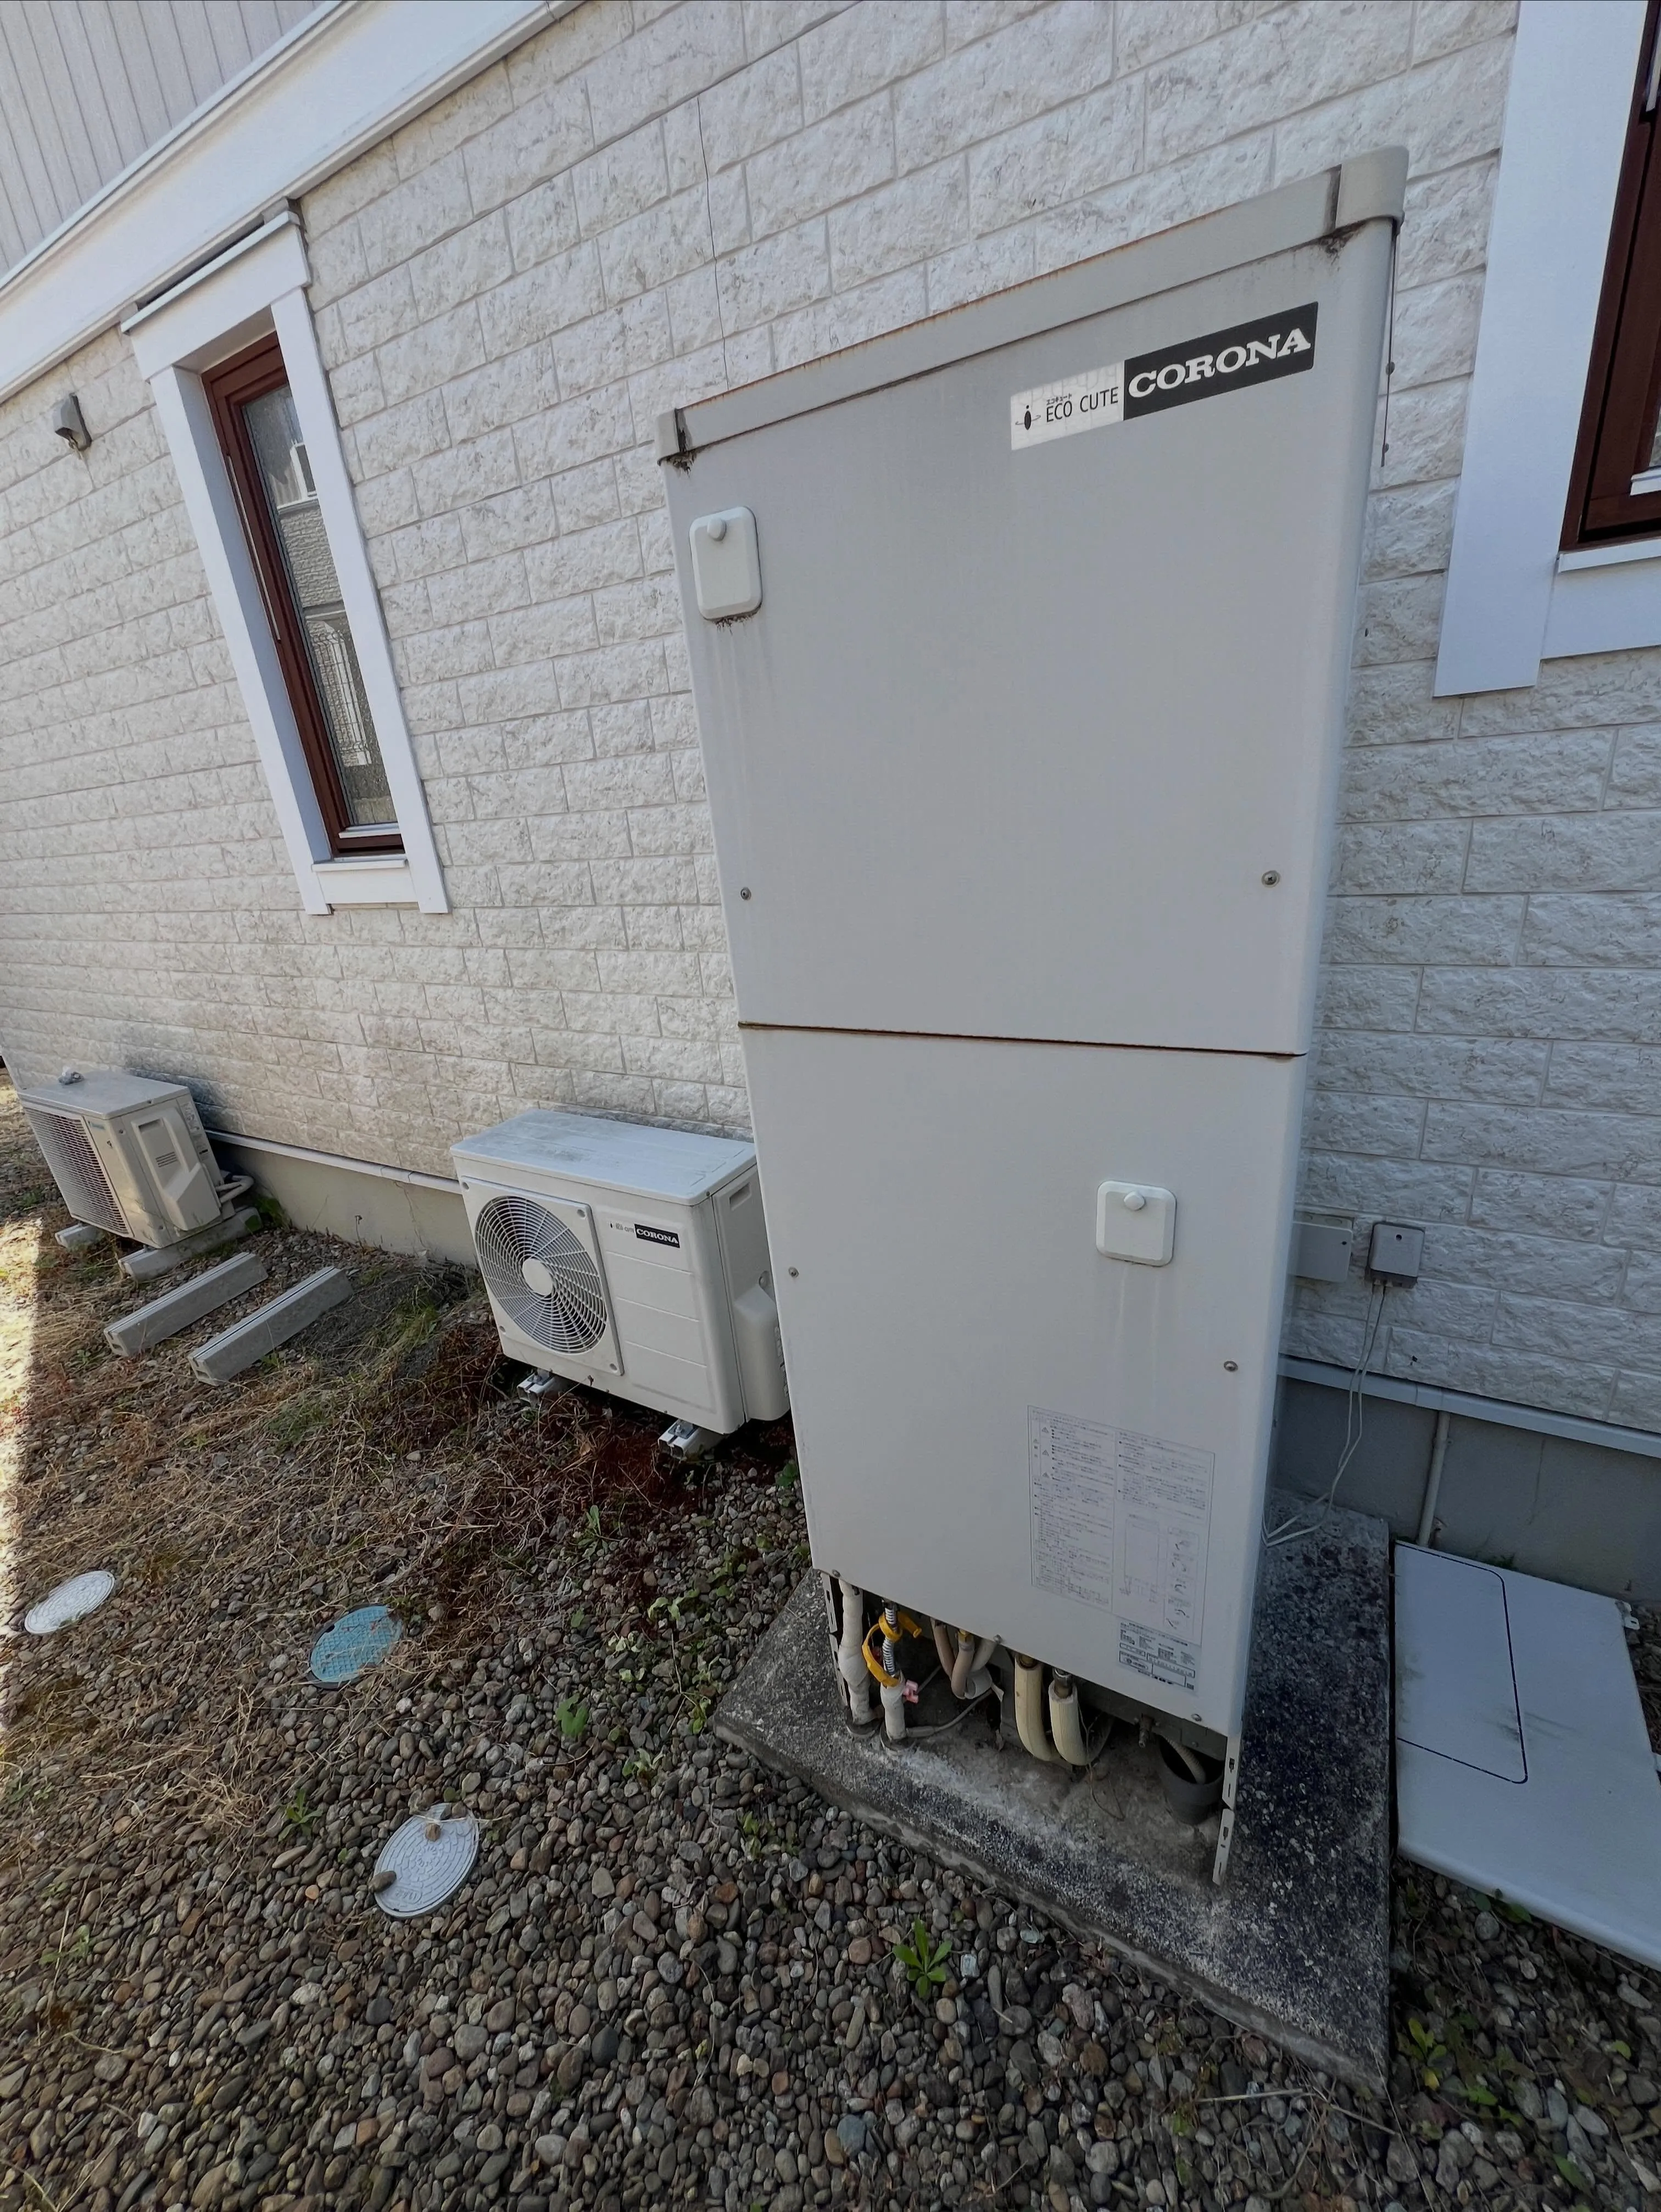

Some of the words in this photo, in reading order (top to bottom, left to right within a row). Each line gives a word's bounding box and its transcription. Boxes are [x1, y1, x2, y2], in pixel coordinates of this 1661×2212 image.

[1128, 328, 1311, 398] CORONA
[1046, 393, 1072, 405] エコキュート
[1046, 400, 1072, 422] ECO
[1080, 387, 1118, 412] CUTE
[636, 1228, 679, 1244] CORONA
